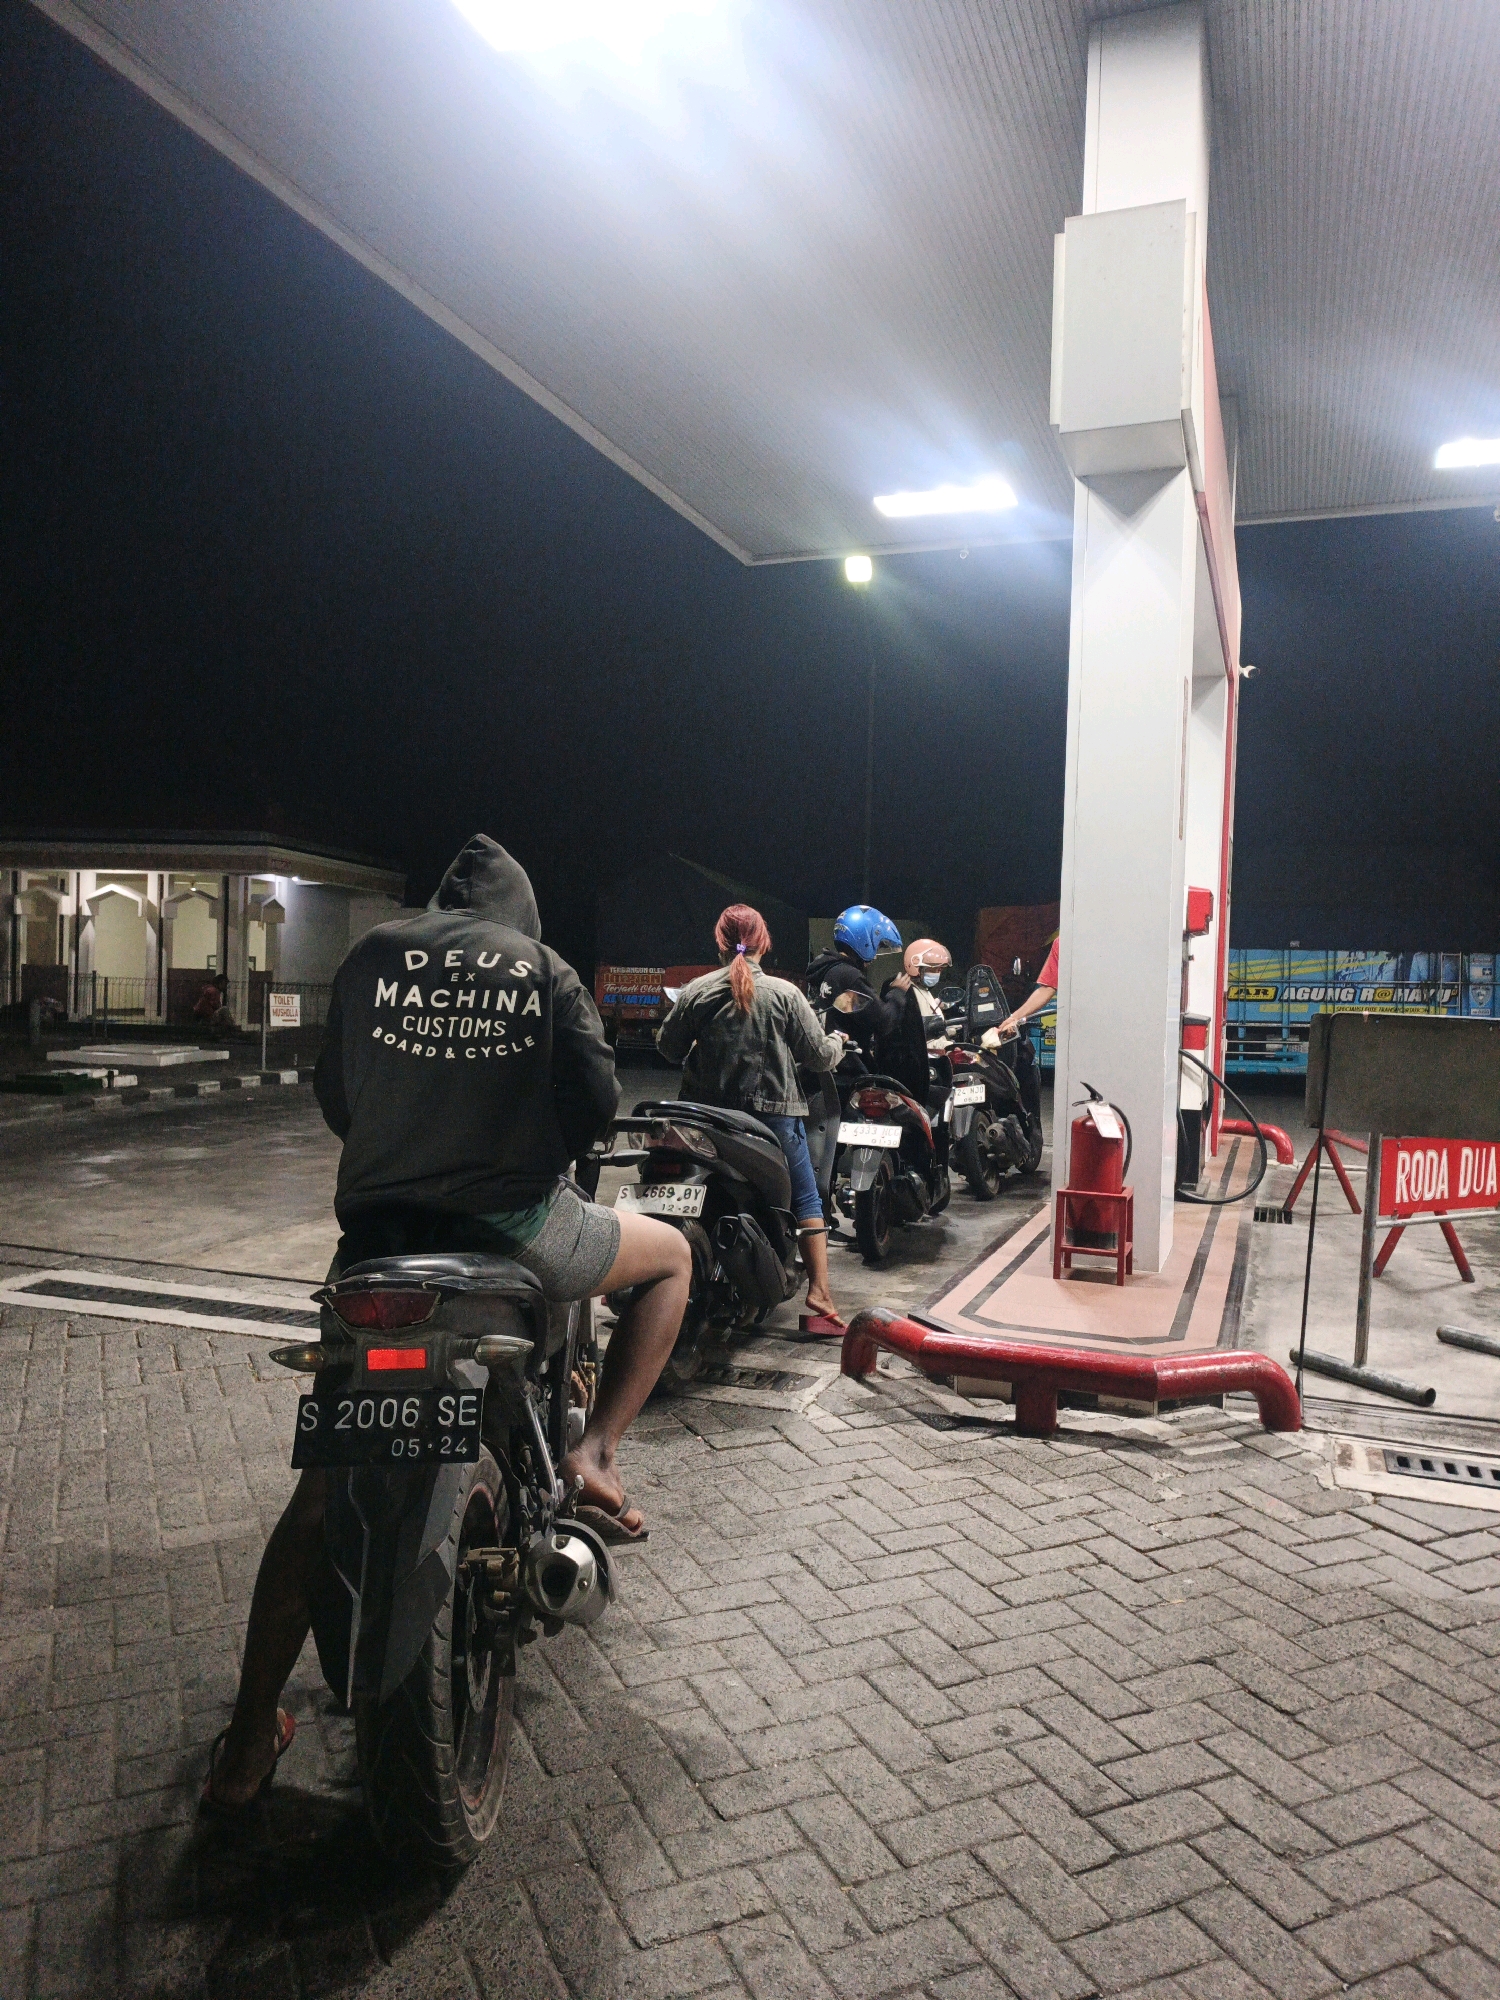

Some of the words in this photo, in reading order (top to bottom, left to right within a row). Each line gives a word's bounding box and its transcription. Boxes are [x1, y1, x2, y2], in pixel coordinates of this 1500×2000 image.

[404, 950, 533, 978] DEUS
[450, 972, 477, 982] EX
[273, 995, 295, 1005] TOILET
[374, 978, 542, 1017] MACHINA
[1234, 988, 1269, 996] AR
[1280, 987, 1355, 1001] AGUNG
[272, 1008, 299, 1017] MUSHOLLA
[402, 1015, 507, 1038] CUSTOMS
[372, 1026, 437, 1058] BOARD
[445, 1047, 456, 1059] &
[465, 1035, 535, 1059] CYCLE
[1395, 1148, 1449, 1203] RODA
[1458, 1146, 1497, 1198] DUA
[620, 1187, 629, 1199] S
[300, 1402, 320, 1432] S
[334, 1398, 420, 1430] 2006
[437, 1395, 478, 1427] SE
